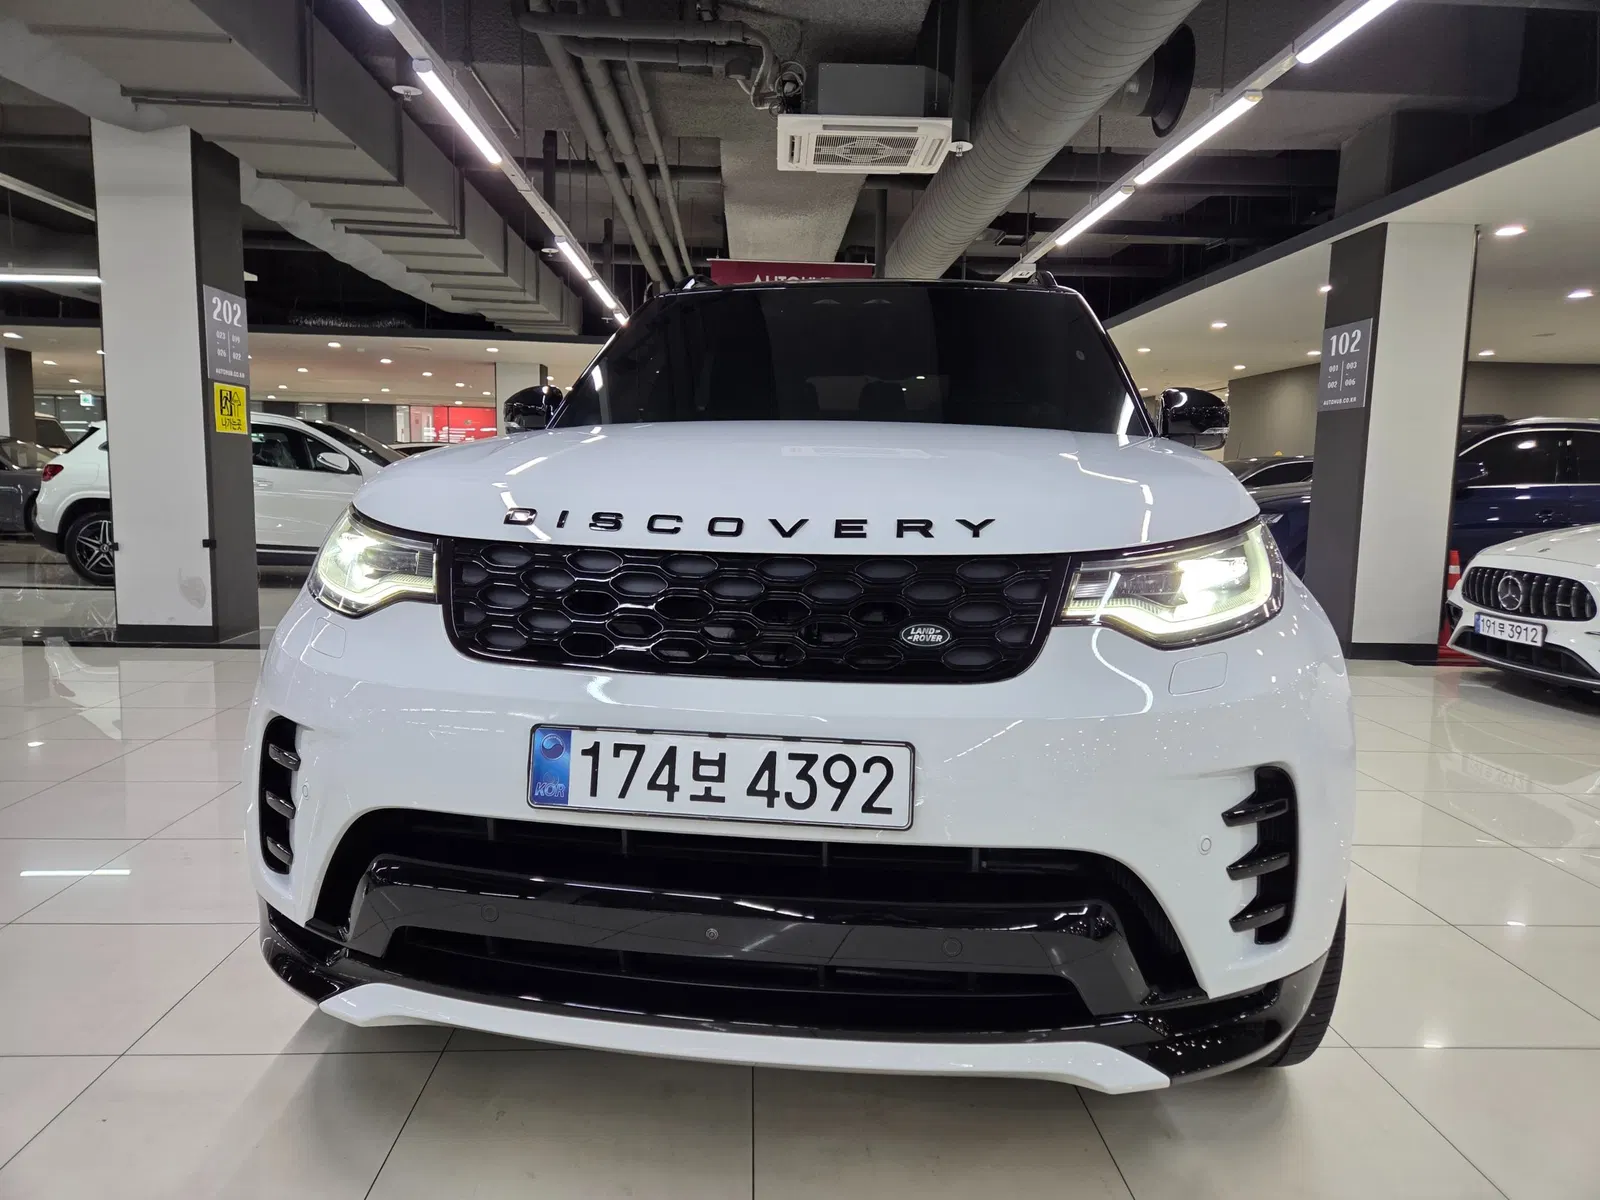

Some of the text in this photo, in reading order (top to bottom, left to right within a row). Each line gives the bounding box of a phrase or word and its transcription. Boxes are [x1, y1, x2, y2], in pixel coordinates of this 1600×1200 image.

[212, 297, 242, 327] 202
[1330, 329, 1361, 356] 102
[1329, 364, 1339, 373] 001
[1346, 361, 1357, 370] 003
[1327, 380, 1338, 389] 002
[1344, 378, 1356, 387] 006
[1323, 396, 1357, 406] AUTOHUB.CO.KR
[503, 507, 996, 538] DISCOVERY
[910, 627, 935, 635] LAND
[1481, 617, 1538, 643] 191무 3912
[912, 634, 943, 642] ROVER
[580, 741, 895, 815] 174보 4392
[534, 781, 566, 798] KOR
